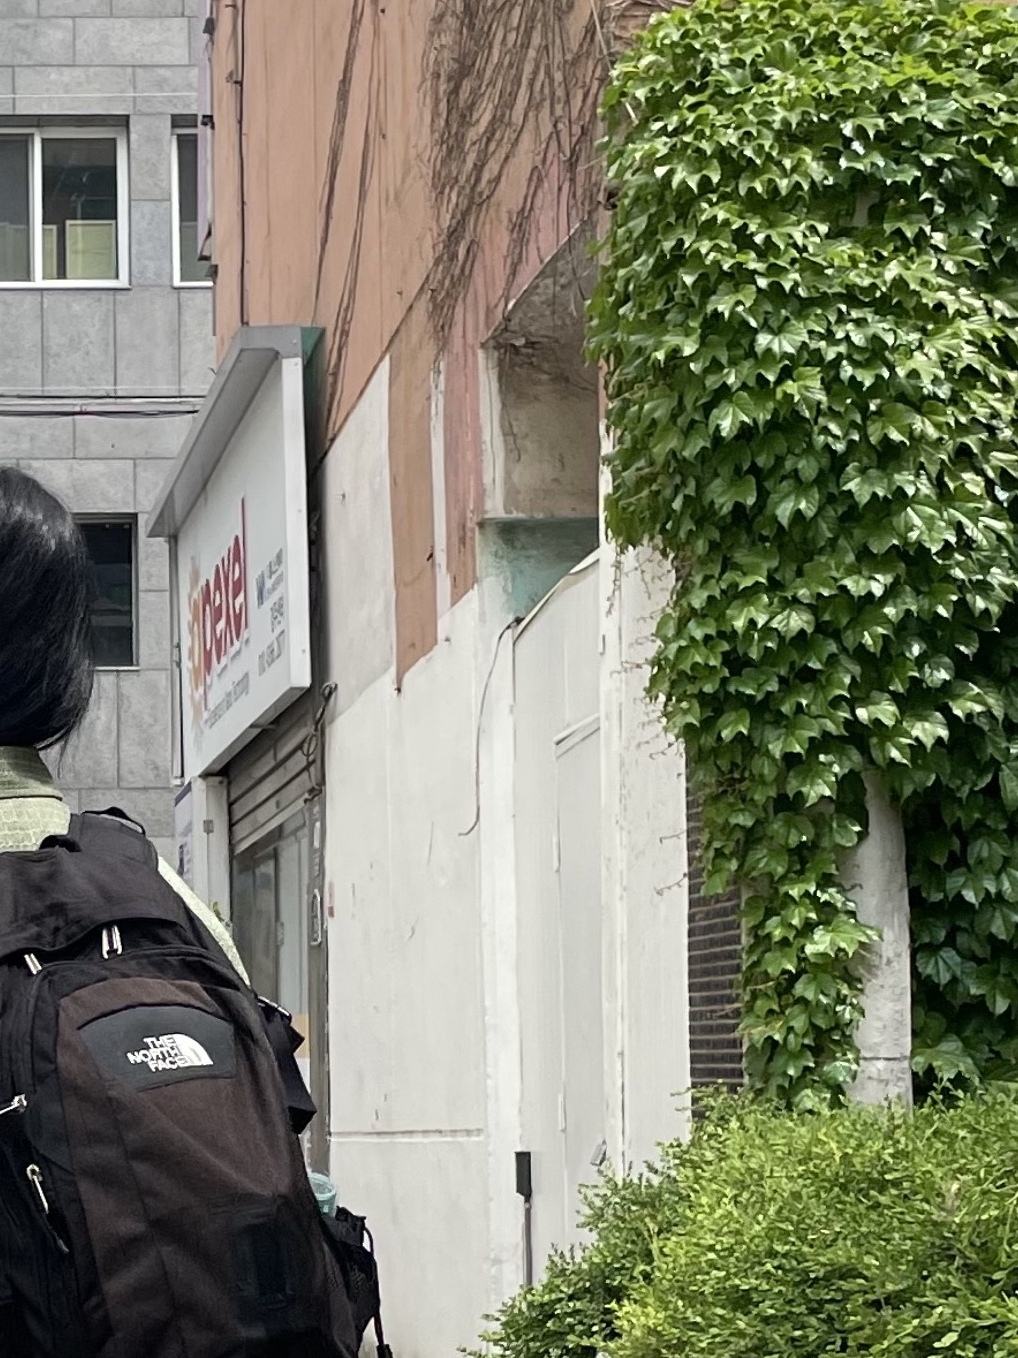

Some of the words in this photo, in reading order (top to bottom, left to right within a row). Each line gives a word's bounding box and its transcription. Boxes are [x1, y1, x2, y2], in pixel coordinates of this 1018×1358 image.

[143, 1034, 176, 1049] THE
[126, 1045, 183, 1065] NORTH
[148, 1055, 189, 1073] FACE
